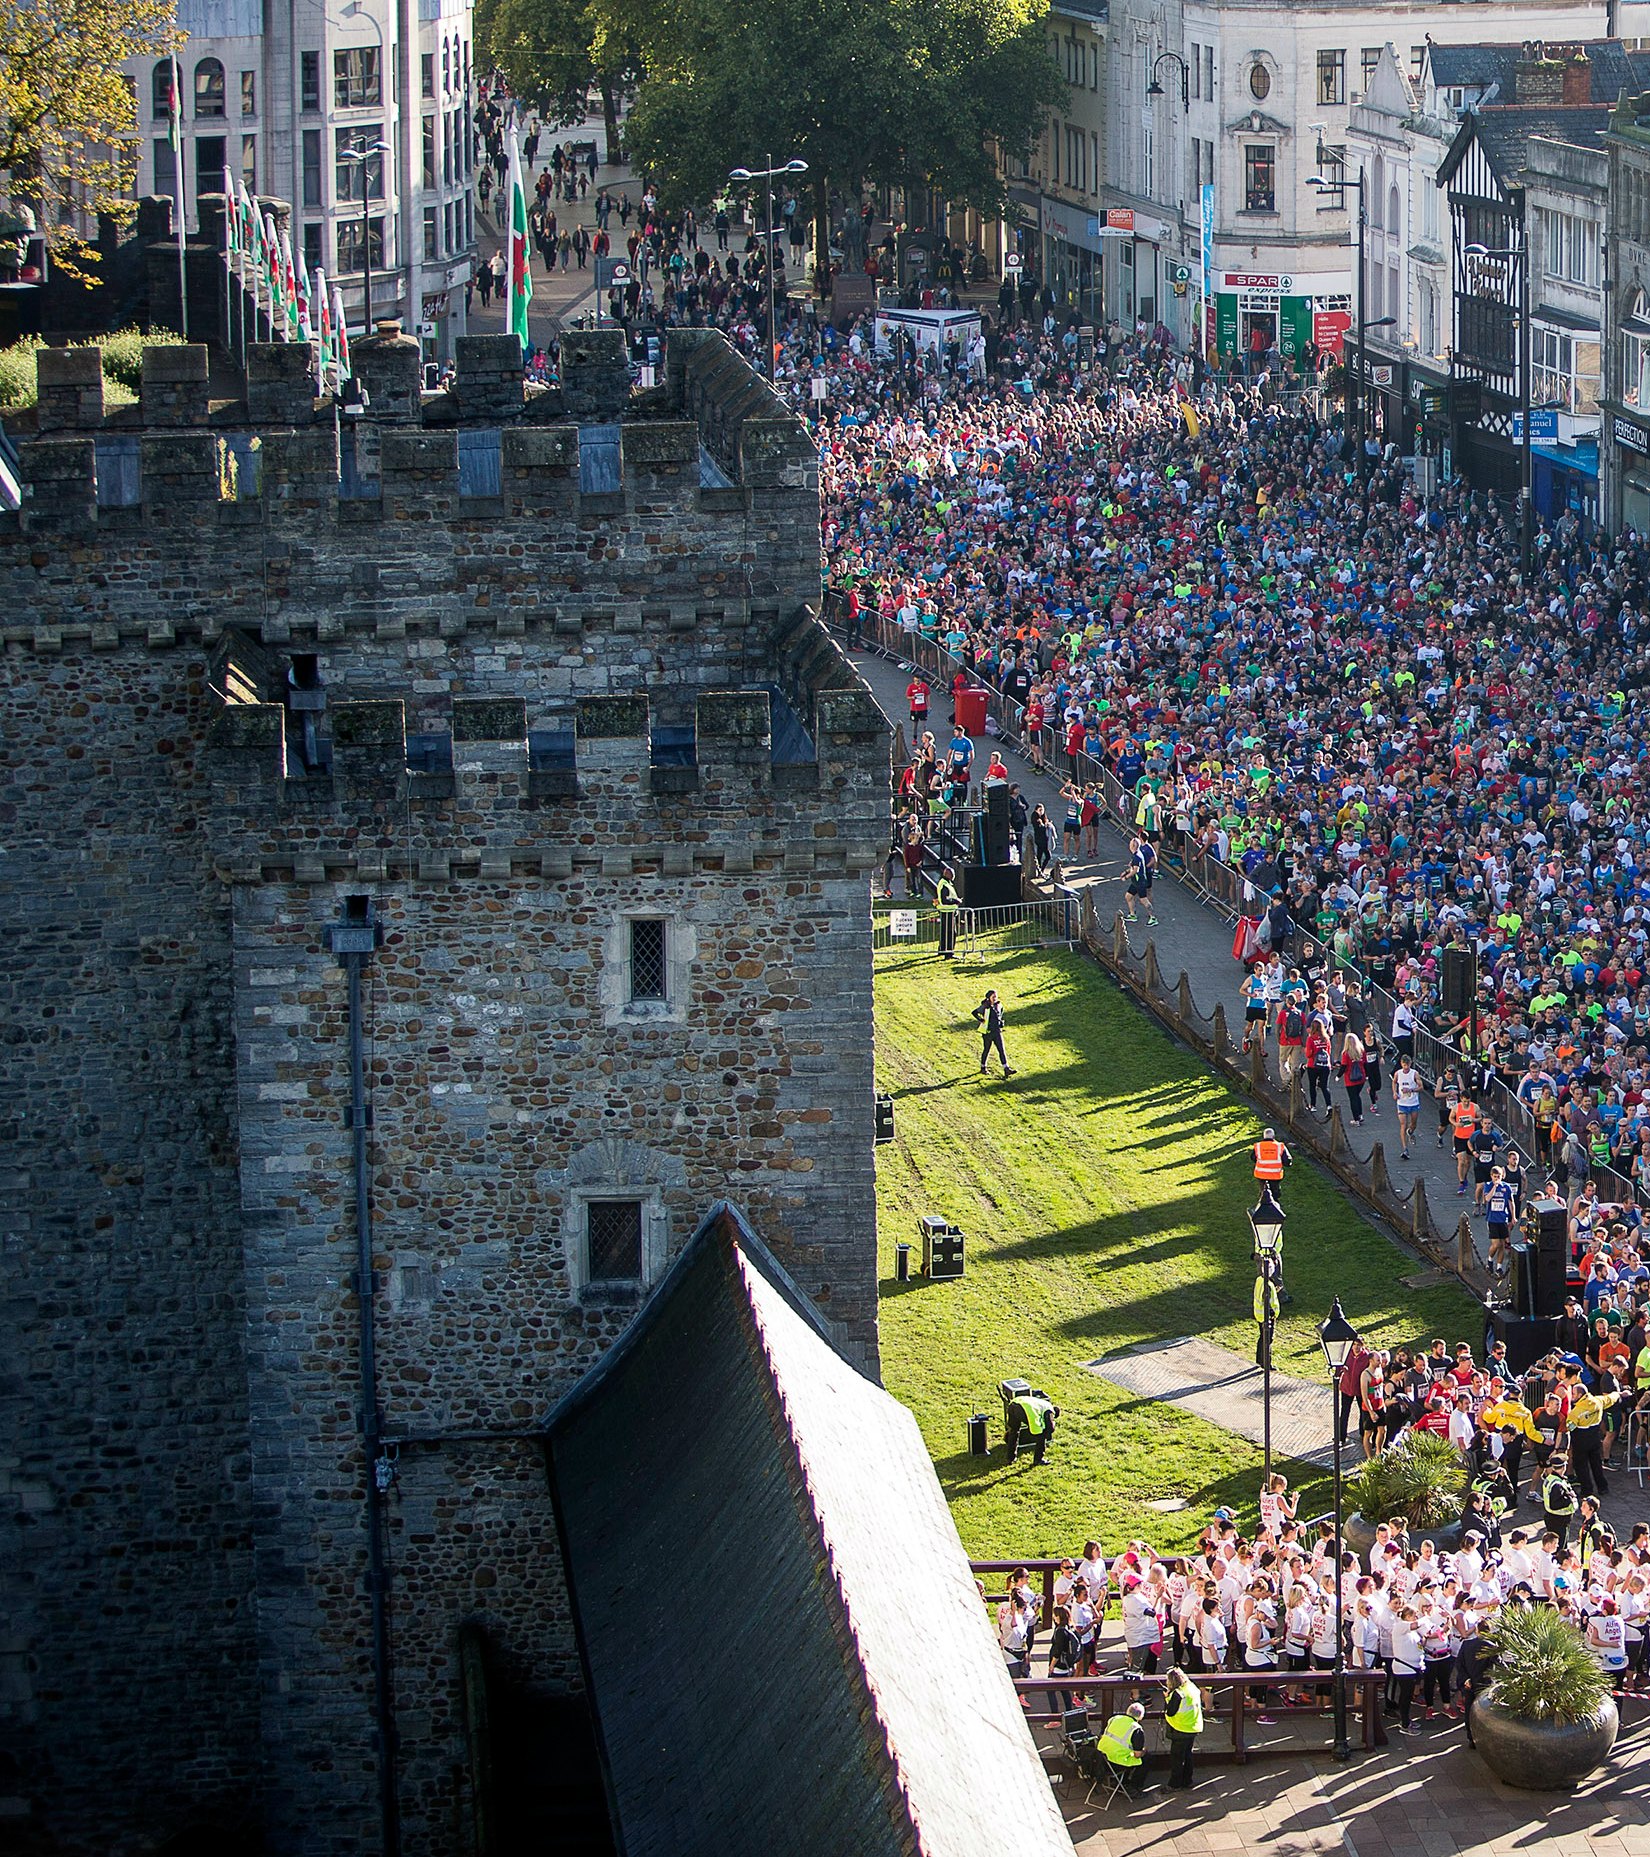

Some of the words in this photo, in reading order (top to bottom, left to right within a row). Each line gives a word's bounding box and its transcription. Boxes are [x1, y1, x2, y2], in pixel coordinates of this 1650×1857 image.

[1236, 276, 1278, 285] SPAR
[1247, 286, 1292, 294] express
[1518, 419, 1552, 427] eanuel
[1614, 419, 1648, 447] PERFECTION
